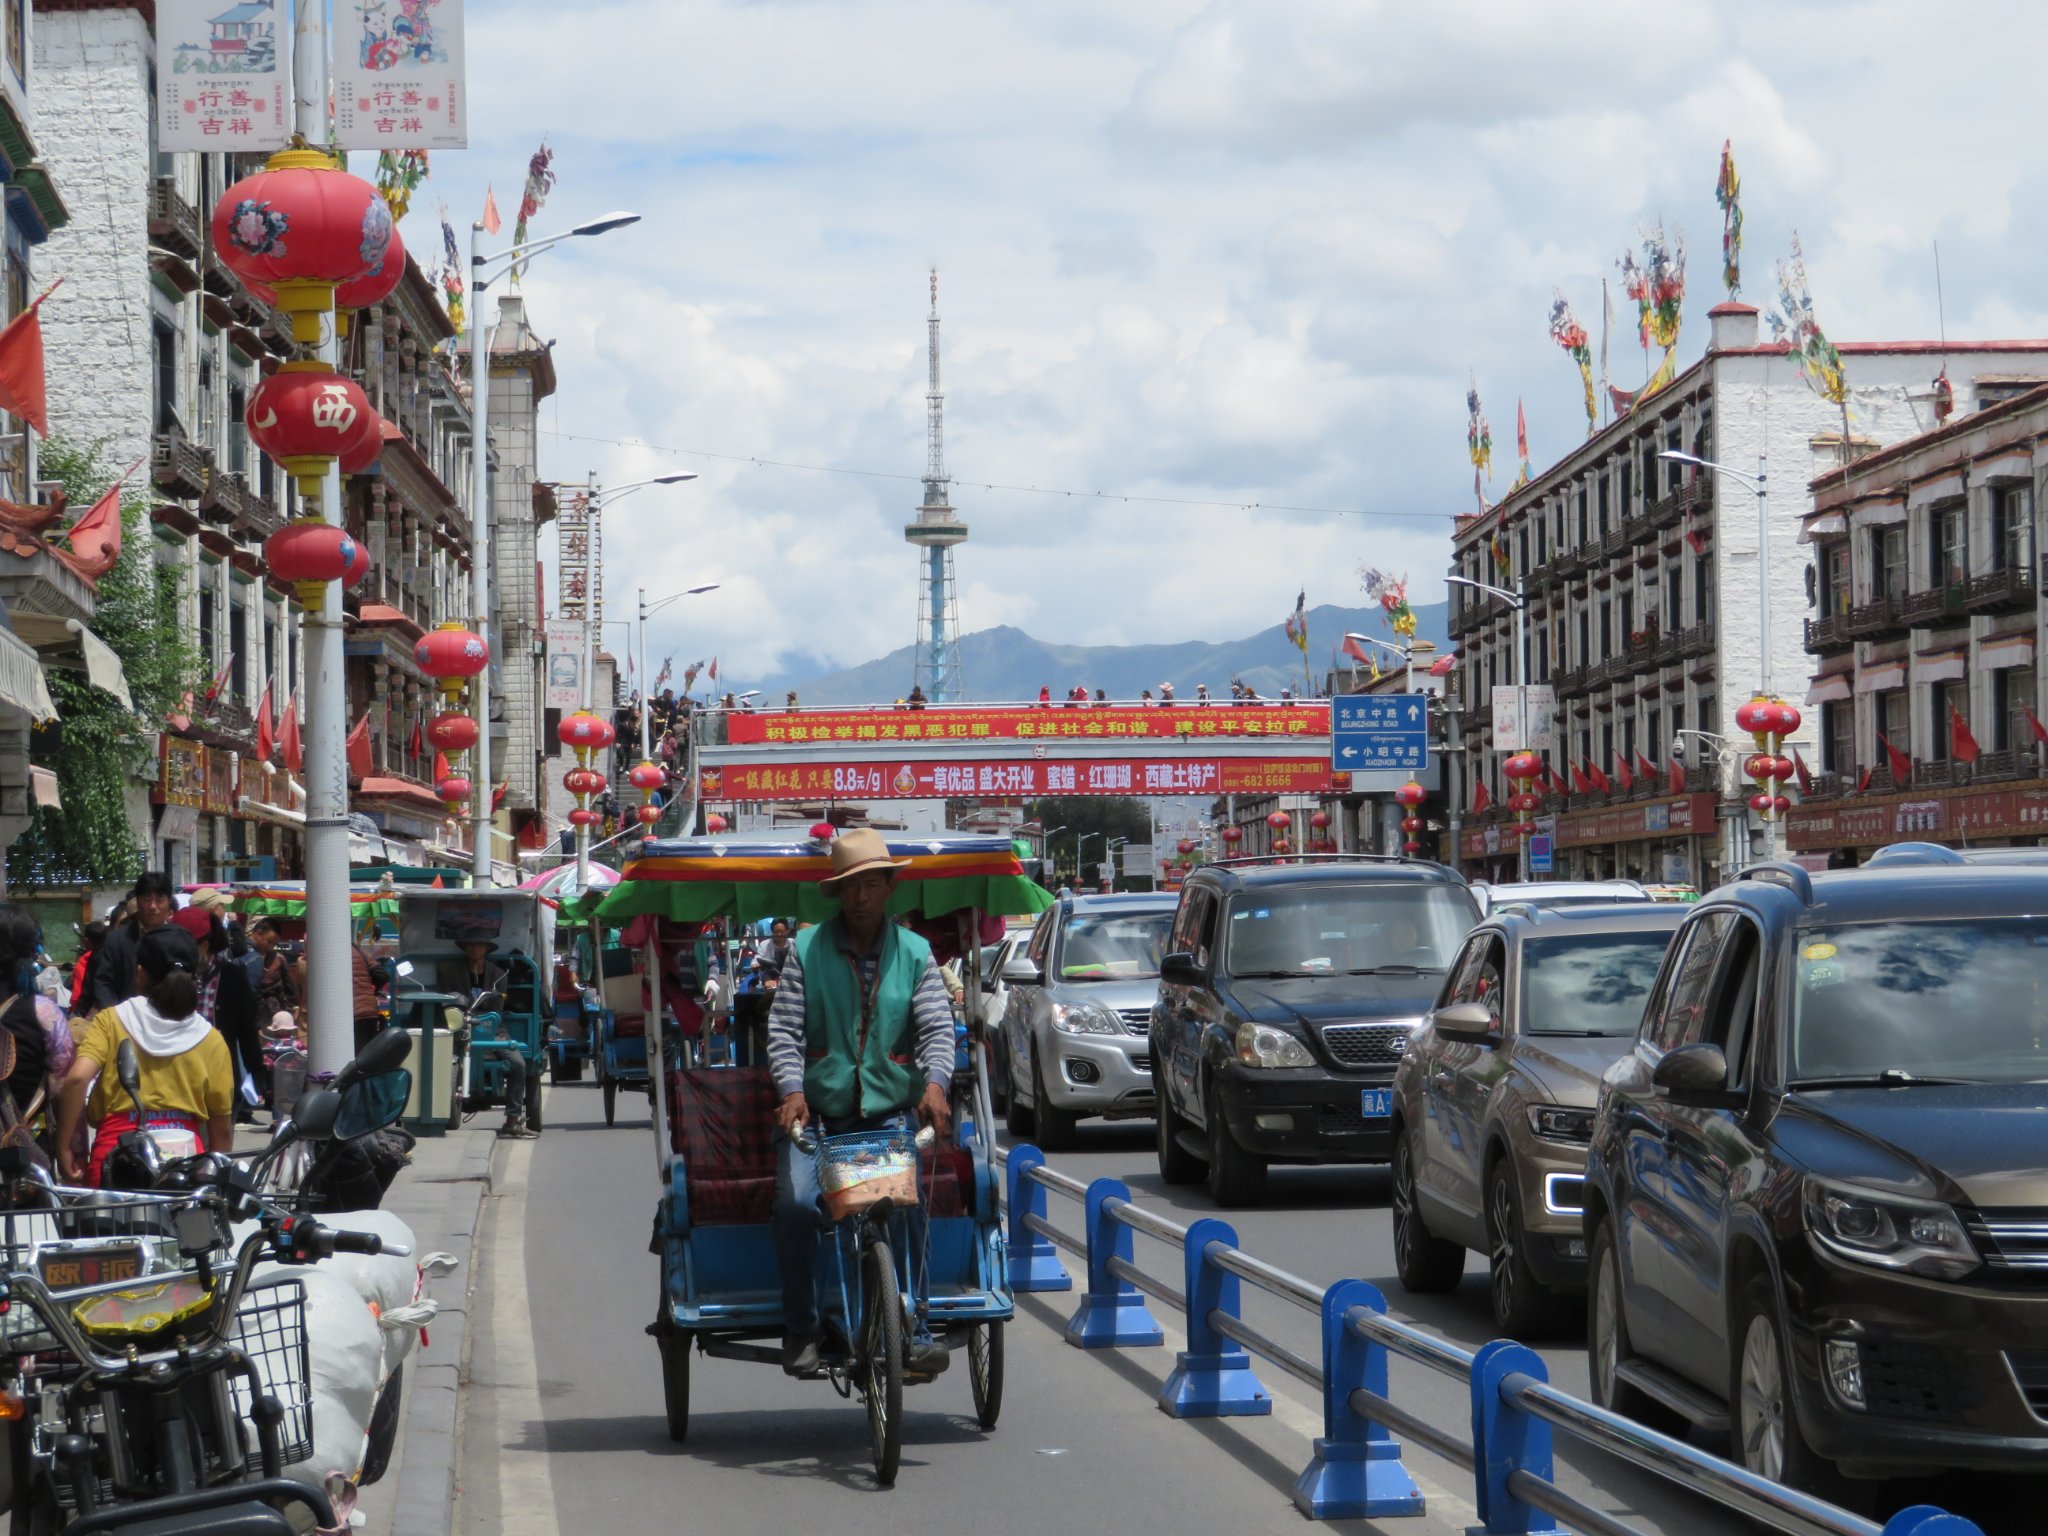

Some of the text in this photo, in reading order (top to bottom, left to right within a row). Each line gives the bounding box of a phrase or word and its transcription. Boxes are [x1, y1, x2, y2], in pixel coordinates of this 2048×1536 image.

[198, 90, 253, 107] 行善
[373, 89, 423, 107] 行善
[198, 117, 254, 135] 吉祥
[373, 117, 424, 133] 吉祥
[1340, 708, 1397, 719] 北京中路
[1383, 720, 1399, 728] ROAD
[1362, 746, 1419, 757] 小昭寺路
[1403, 758, 1417, 766] ROAD
[733, 769, 802, 791] 一级藏红花
[919, 766, 975, 792] 一草优品
[979, 765, 1034, 791] 盛大开业
[1265, 774, 1292, 787] 6666
